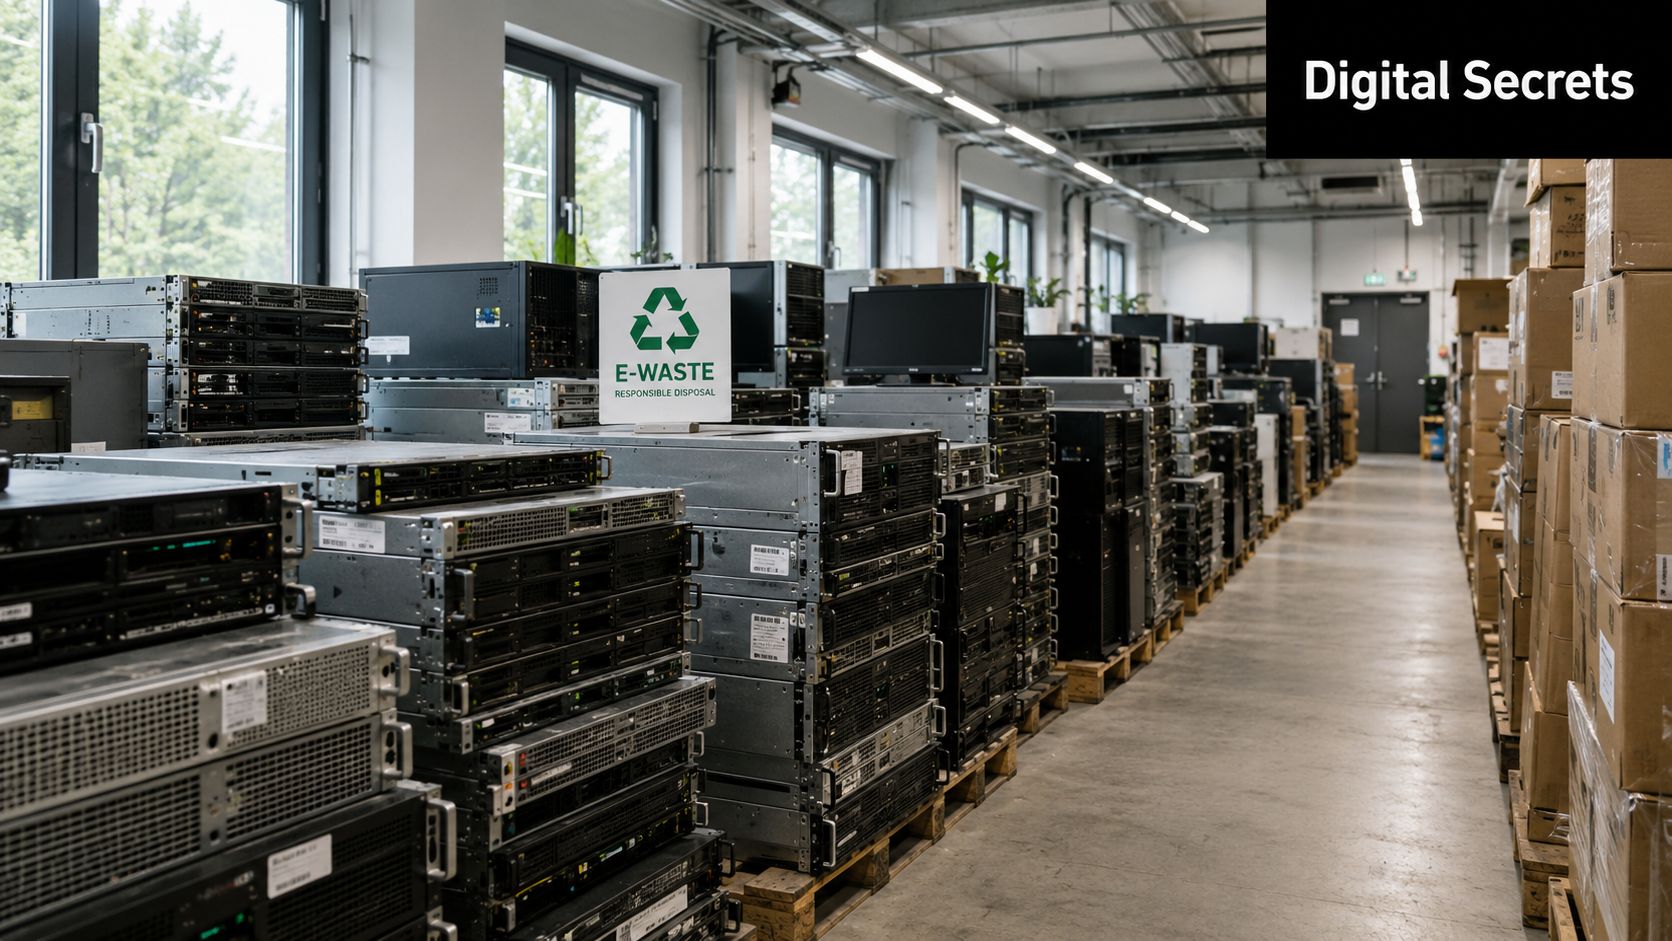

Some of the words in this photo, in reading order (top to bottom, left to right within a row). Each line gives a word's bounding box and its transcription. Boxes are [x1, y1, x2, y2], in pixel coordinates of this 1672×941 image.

[615, 362, 715, 383] E-WASTE
[615, 389, 672, 398] RESPONSIBLE
[674, 388, 716, 397] DISPOSAL
